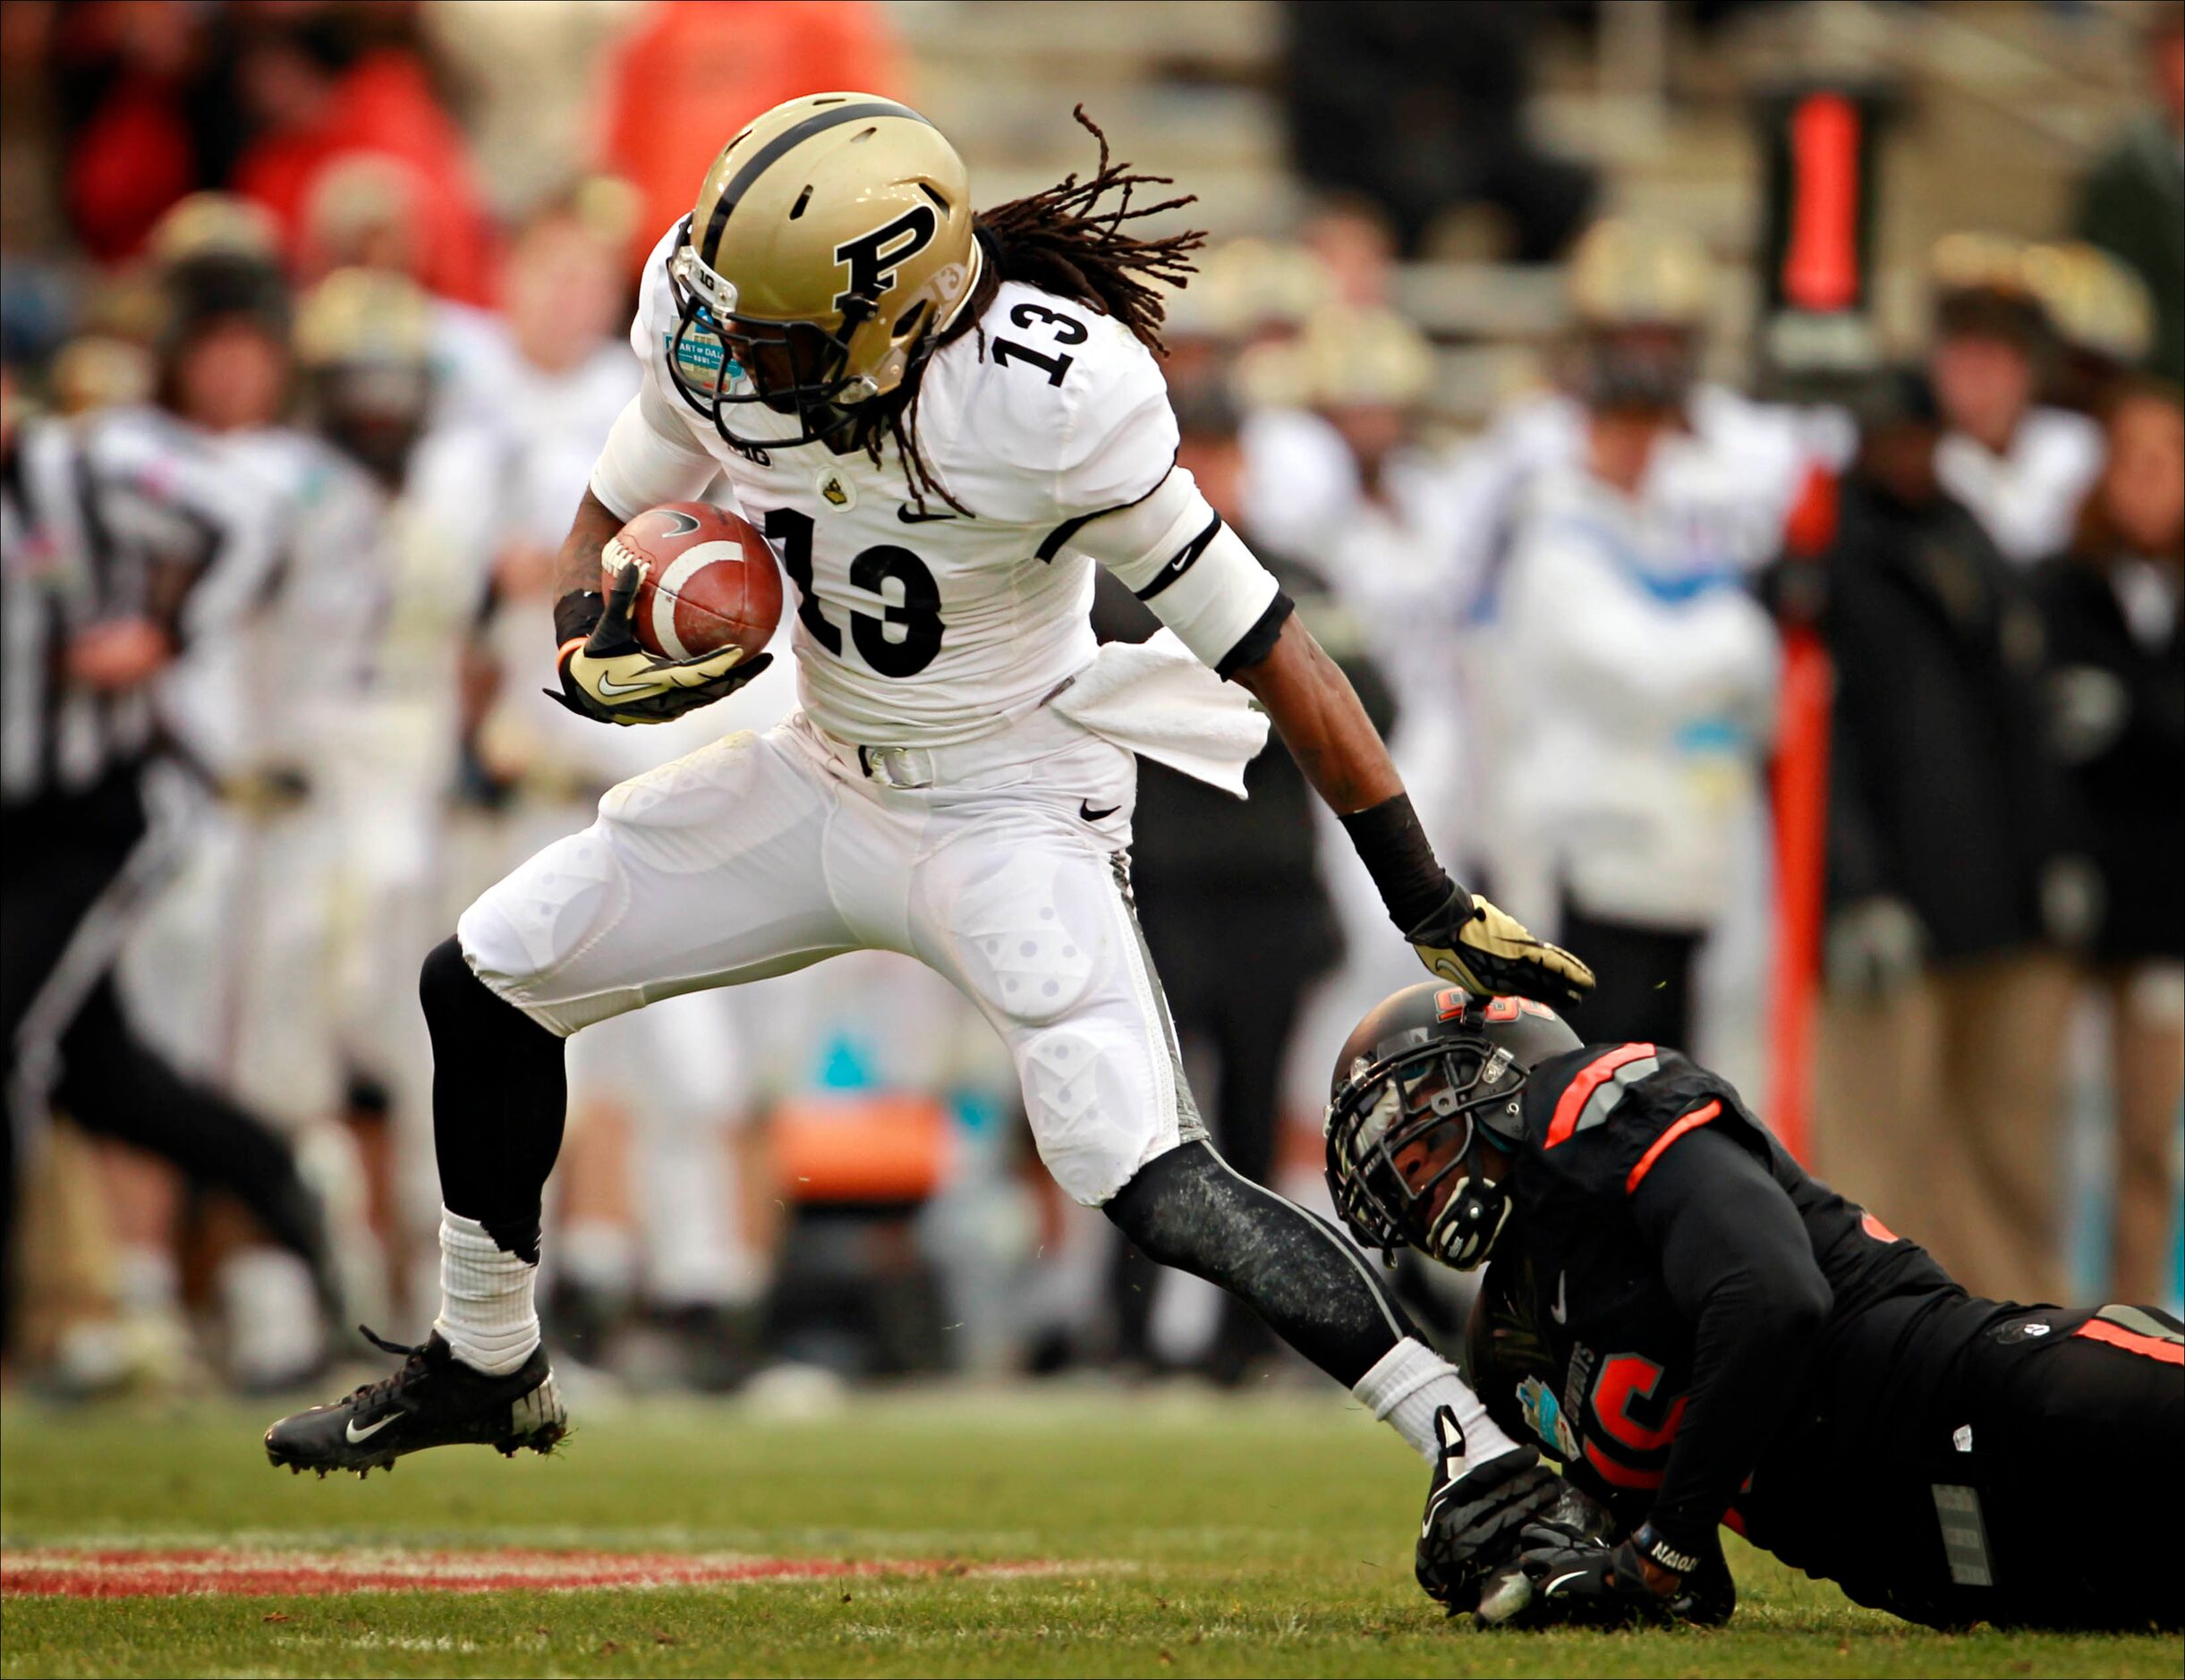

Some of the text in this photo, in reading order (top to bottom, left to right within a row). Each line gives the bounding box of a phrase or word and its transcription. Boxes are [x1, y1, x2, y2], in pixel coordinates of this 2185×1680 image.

[832, 201, 937, 312] P
[990, 302, 1089, 388] 13
[764, 506, 947, 678] 13
